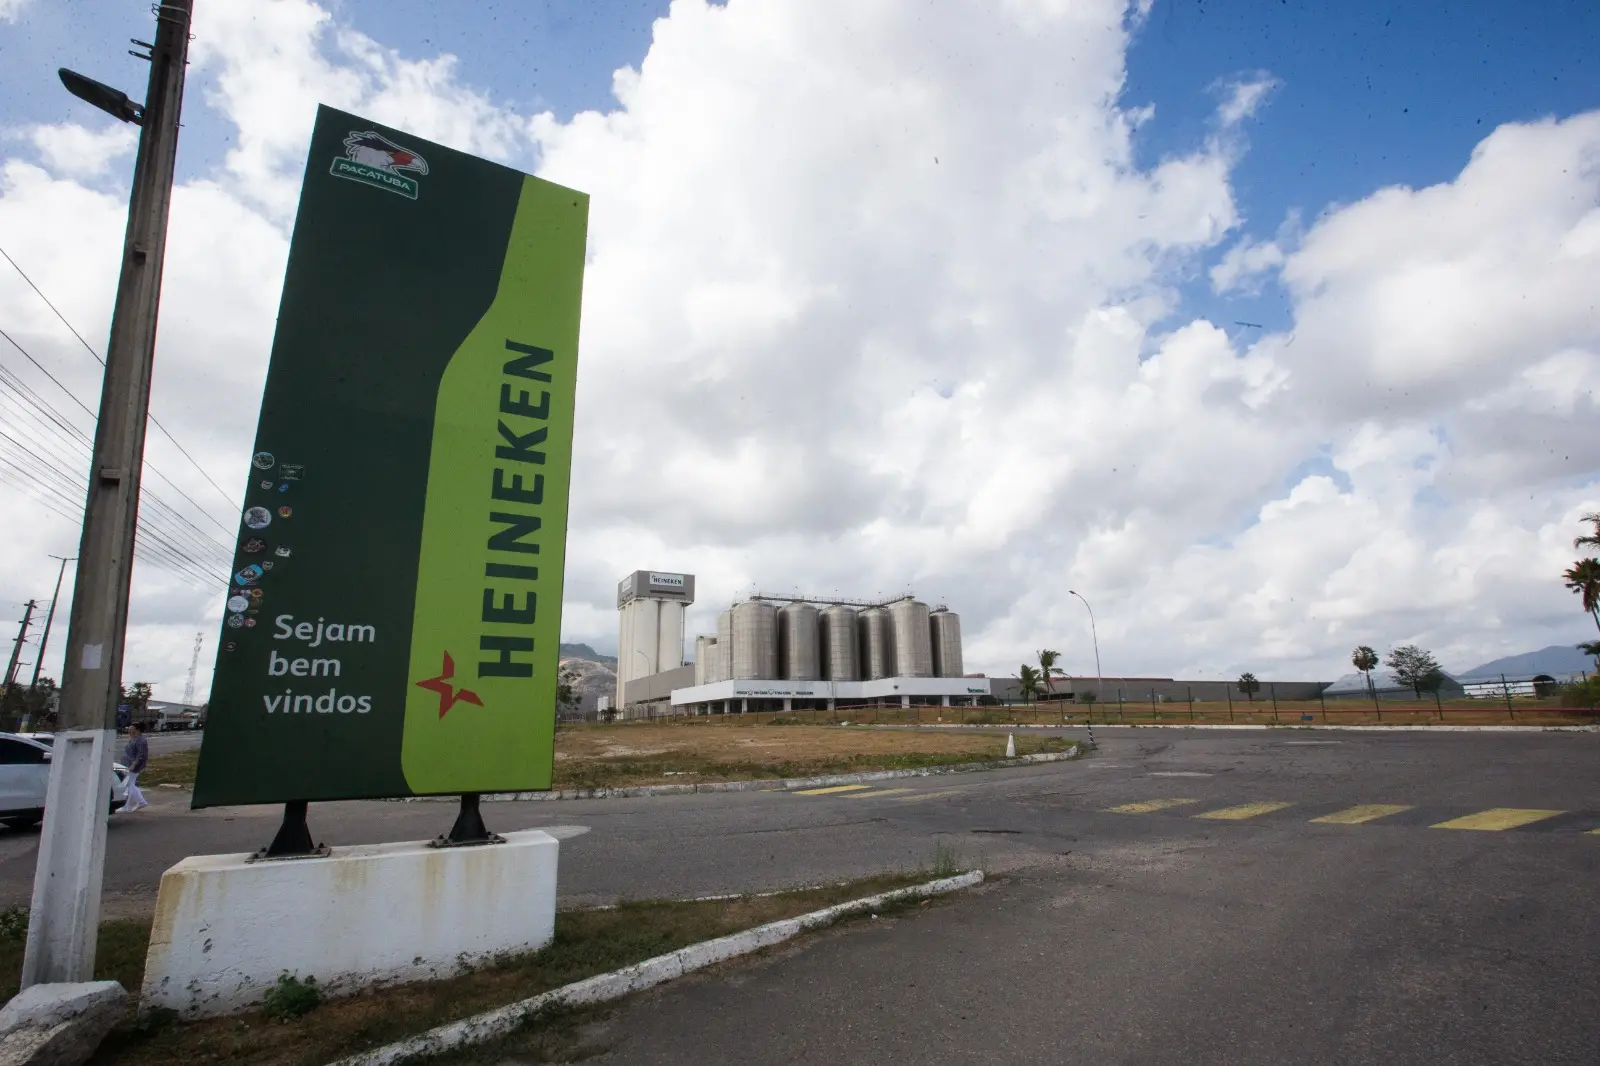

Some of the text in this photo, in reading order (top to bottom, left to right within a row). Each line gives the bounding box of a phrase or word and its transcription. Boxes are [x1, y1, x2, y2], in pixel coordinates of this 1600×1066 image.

[339, 163, 411, 191] PACATUBA
[477, 338, 555, 680] HEINEKEN
[653, 577, 682, 585] HEINEKEN
[272, 614, 376, 647] Sejam
[268, 650, 341, 677] bem
[263, 687, 372, 714] vindos
